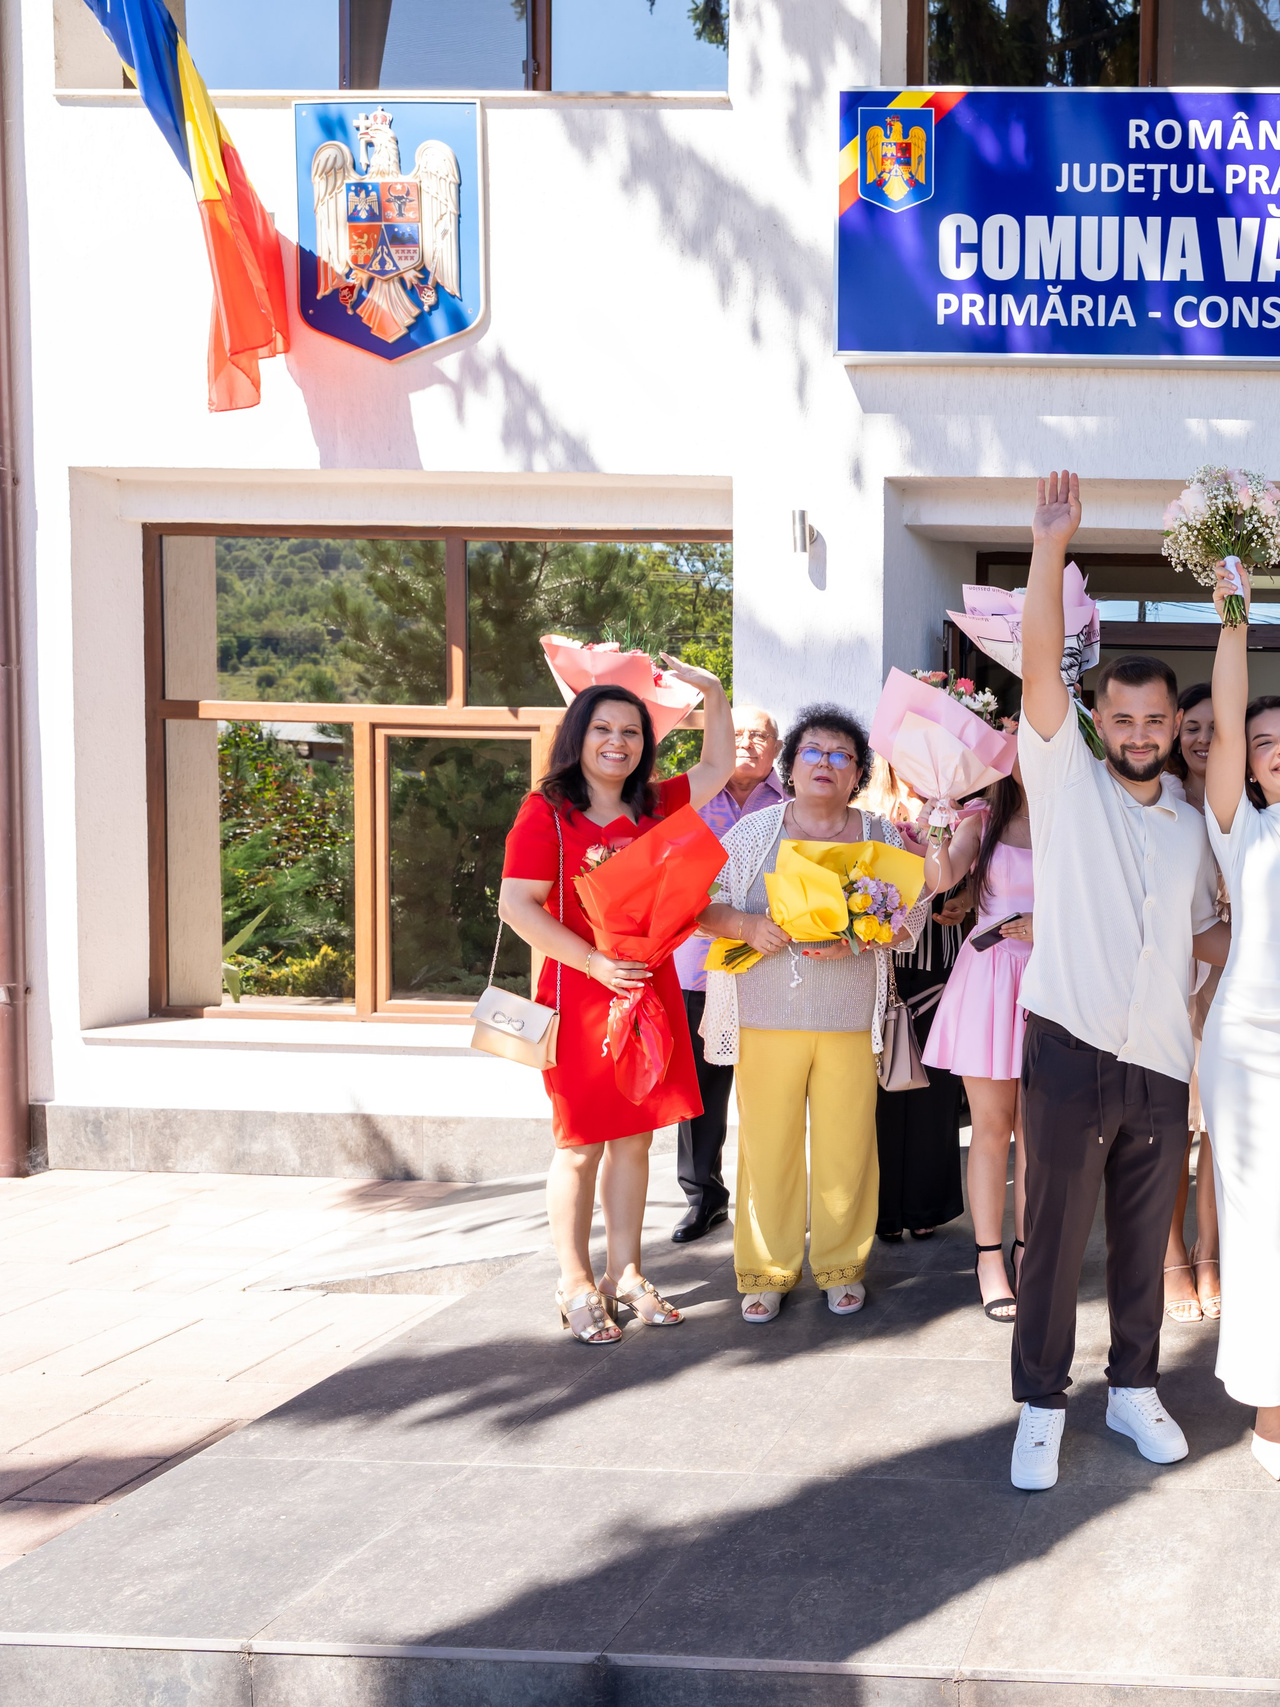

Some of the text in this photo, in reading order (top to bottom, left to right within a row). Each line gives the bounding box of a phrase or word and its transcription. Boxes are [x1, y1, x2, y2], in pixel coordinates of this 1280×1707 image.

[1055, 163, 1214, 201] JUDEȚUL
[938, 213, 1205, 282] COMUNA
[936, 285, 1137, 327] PRIMĂRIA
